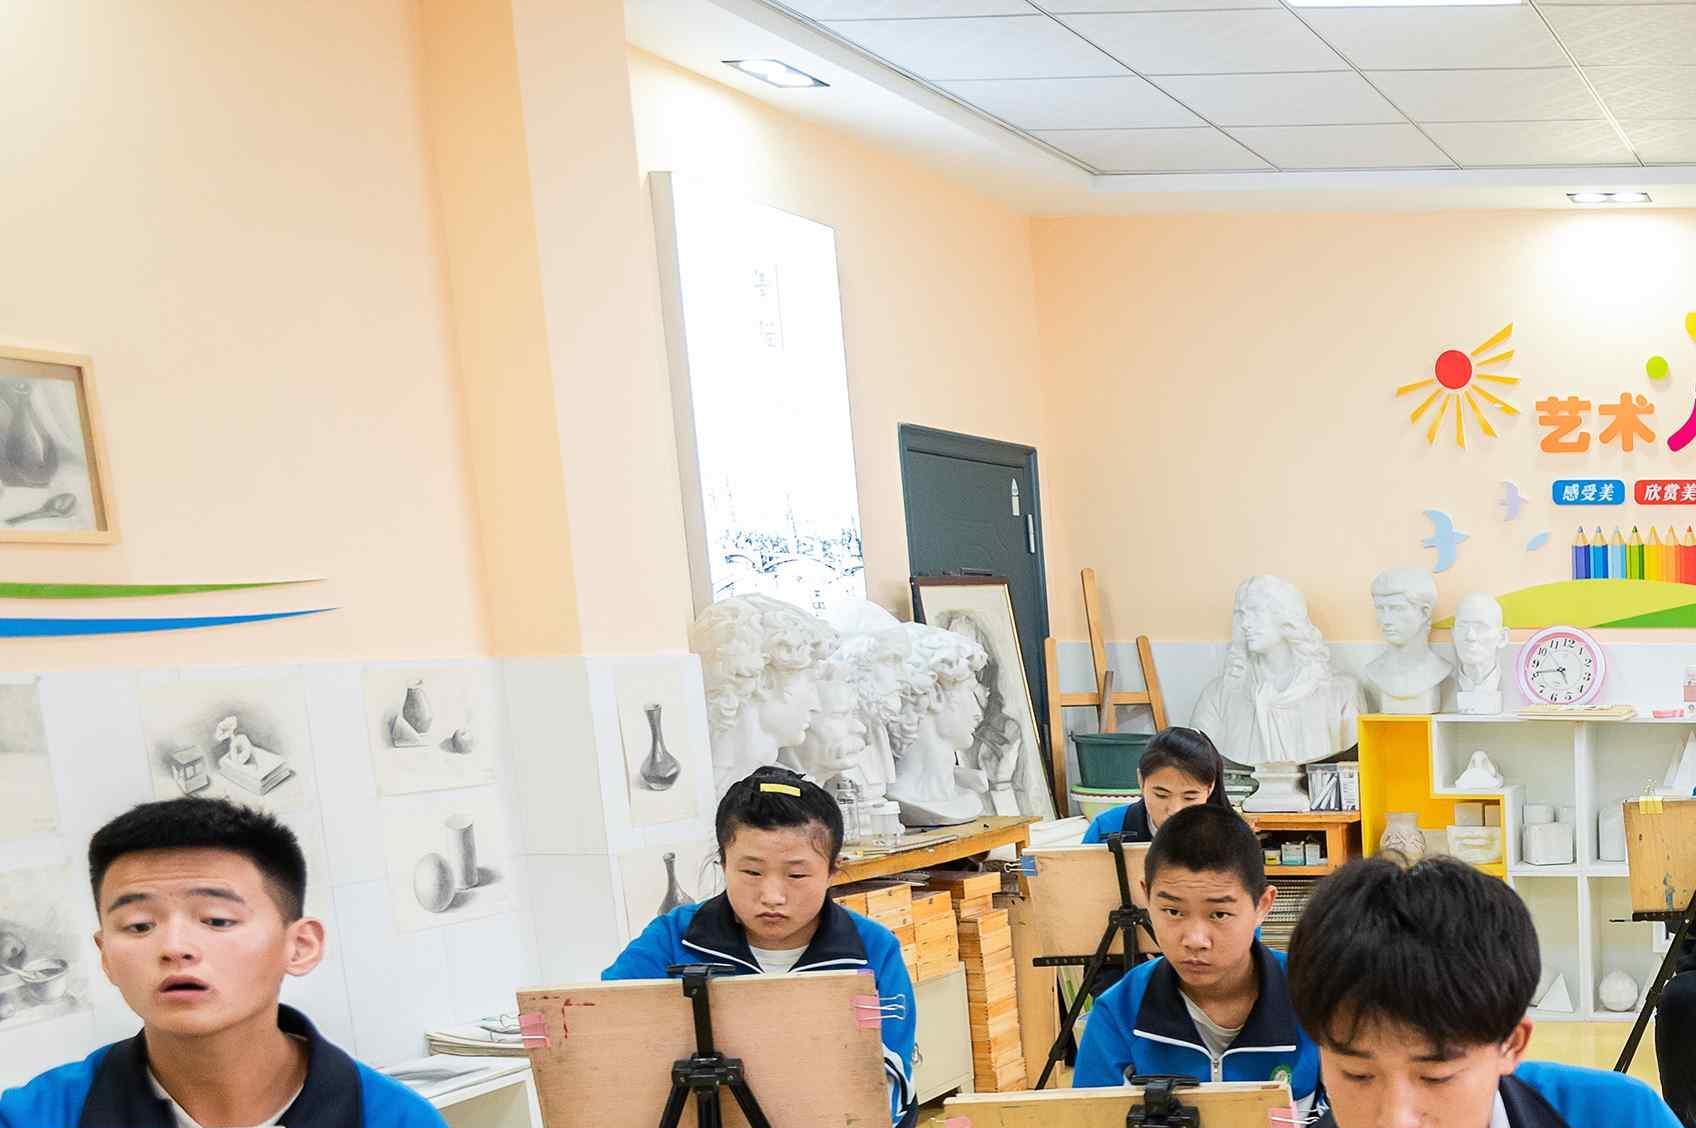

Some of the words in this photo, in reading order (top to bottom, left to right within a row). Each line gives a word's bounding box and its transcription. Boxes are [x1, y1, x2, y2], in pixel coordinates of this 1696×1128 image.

[1562, 483, 1615, 502] 感受美
[1550, 640, 1559, 649] 11
[1563, 638, 1576, 648] 12
